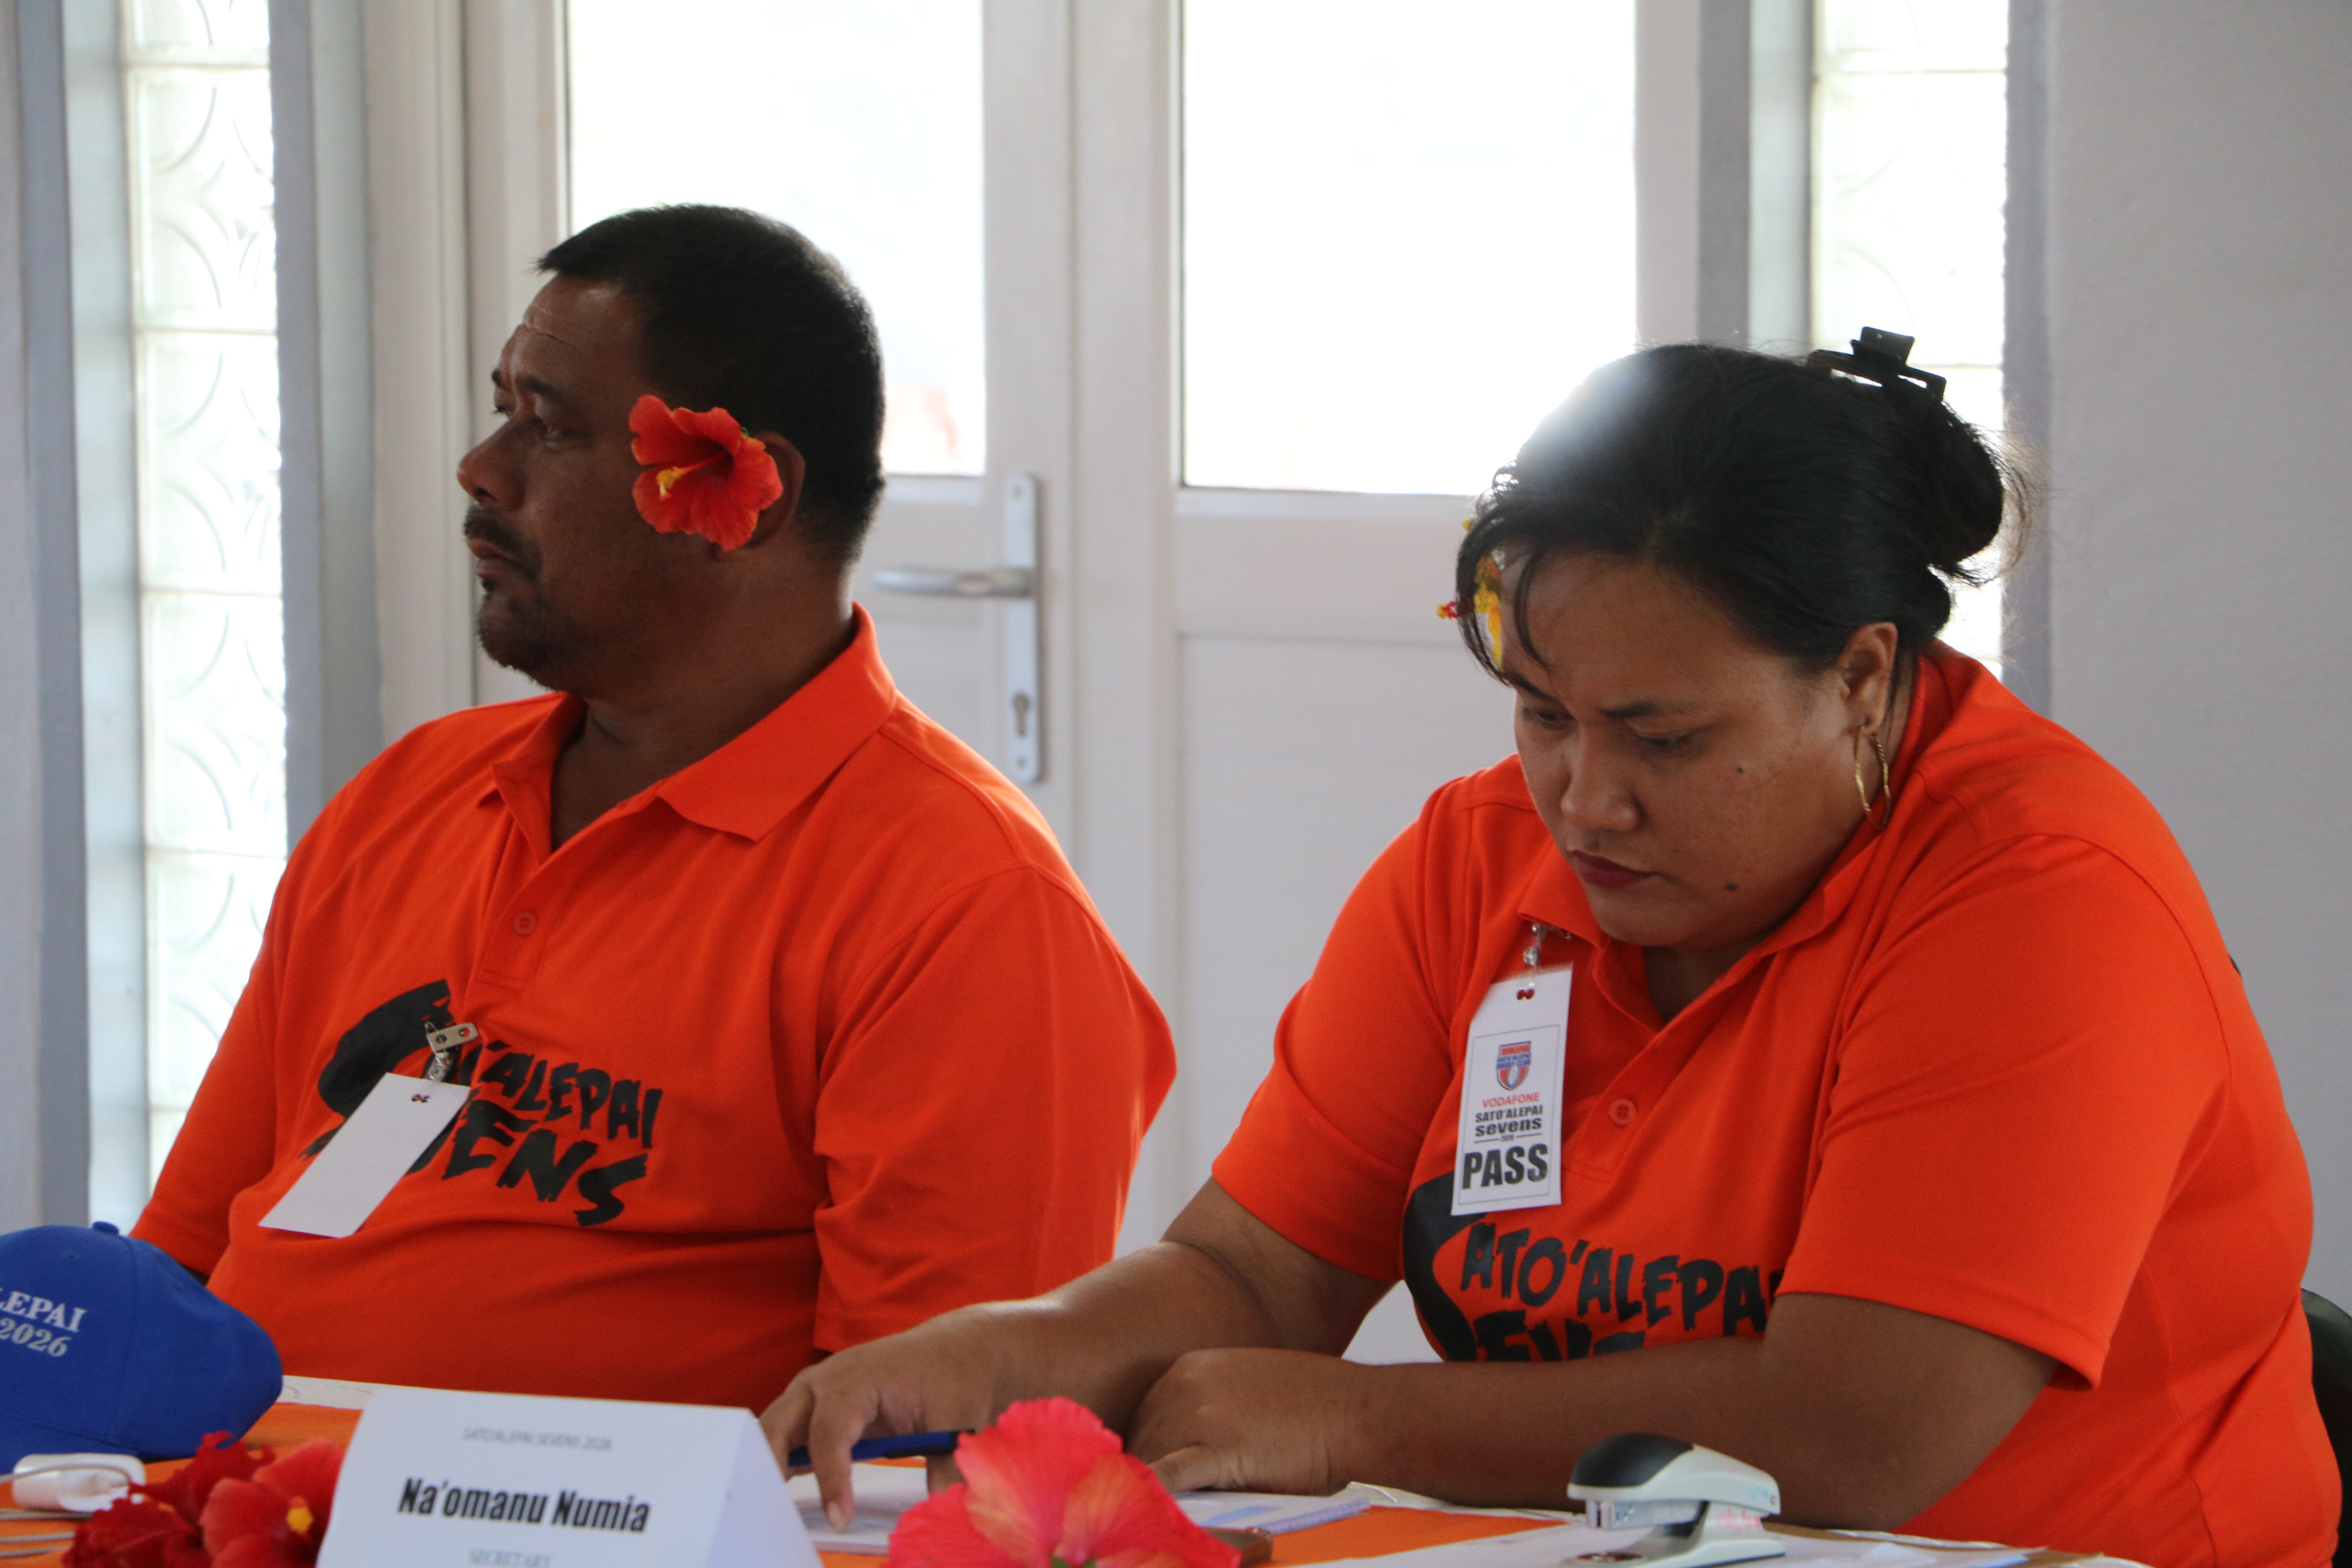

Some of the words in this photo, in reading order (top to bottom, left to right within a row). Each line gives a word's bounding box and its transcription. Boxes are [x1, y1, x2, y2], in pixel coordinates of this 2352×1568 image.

[1482, 1092, 1539, 1108] VODAFONE
[442, 1100, 648, 1226] ENS
[1462, 1143, 1548, 1189] PASS
[0, 1318, 72, 1357] 2026
[397, 1477, 548, 1524] Na'omanu
[552, 1490, 650, 1533] Numia
